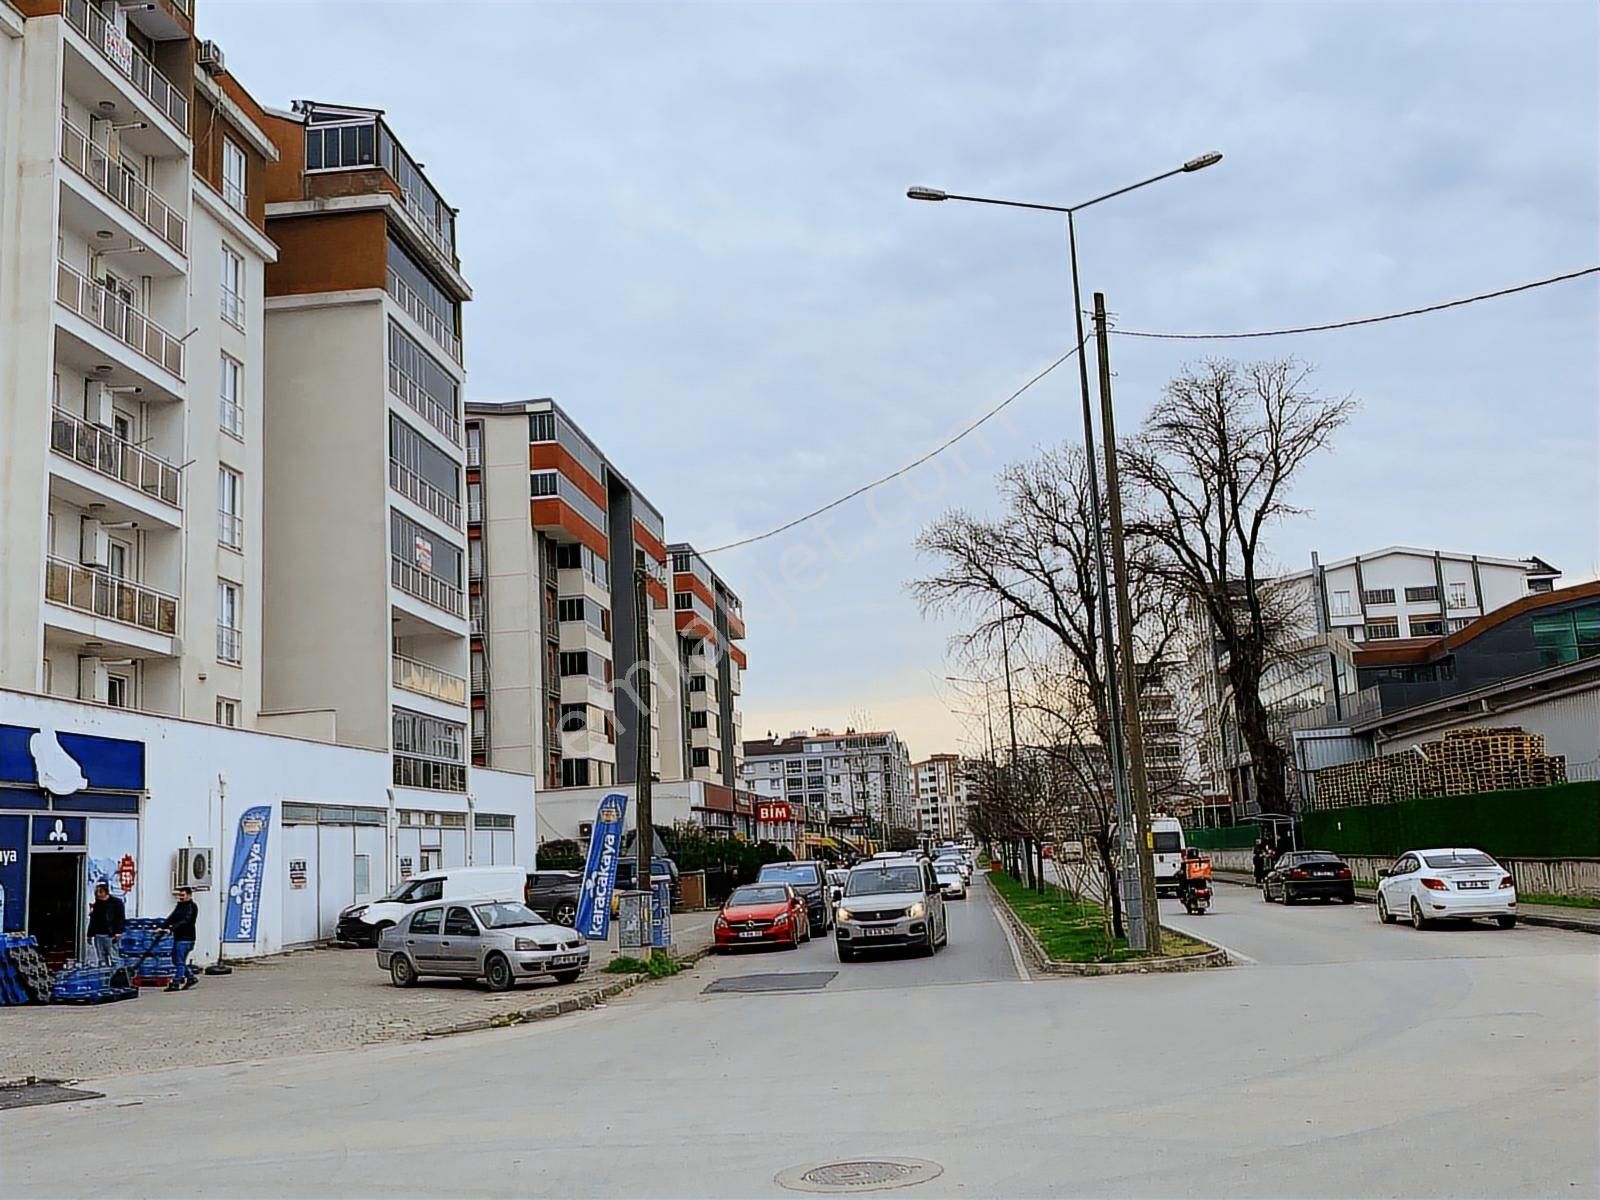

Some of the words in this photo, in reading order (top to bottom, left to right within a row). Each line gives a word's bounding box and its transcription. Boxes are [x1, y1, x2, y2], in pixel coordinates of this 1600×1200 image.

[760, 804, 787, 819] BİM
[237, 843, 262, 939] karacakaya
[589, 834, 616, 936] karacakaya
